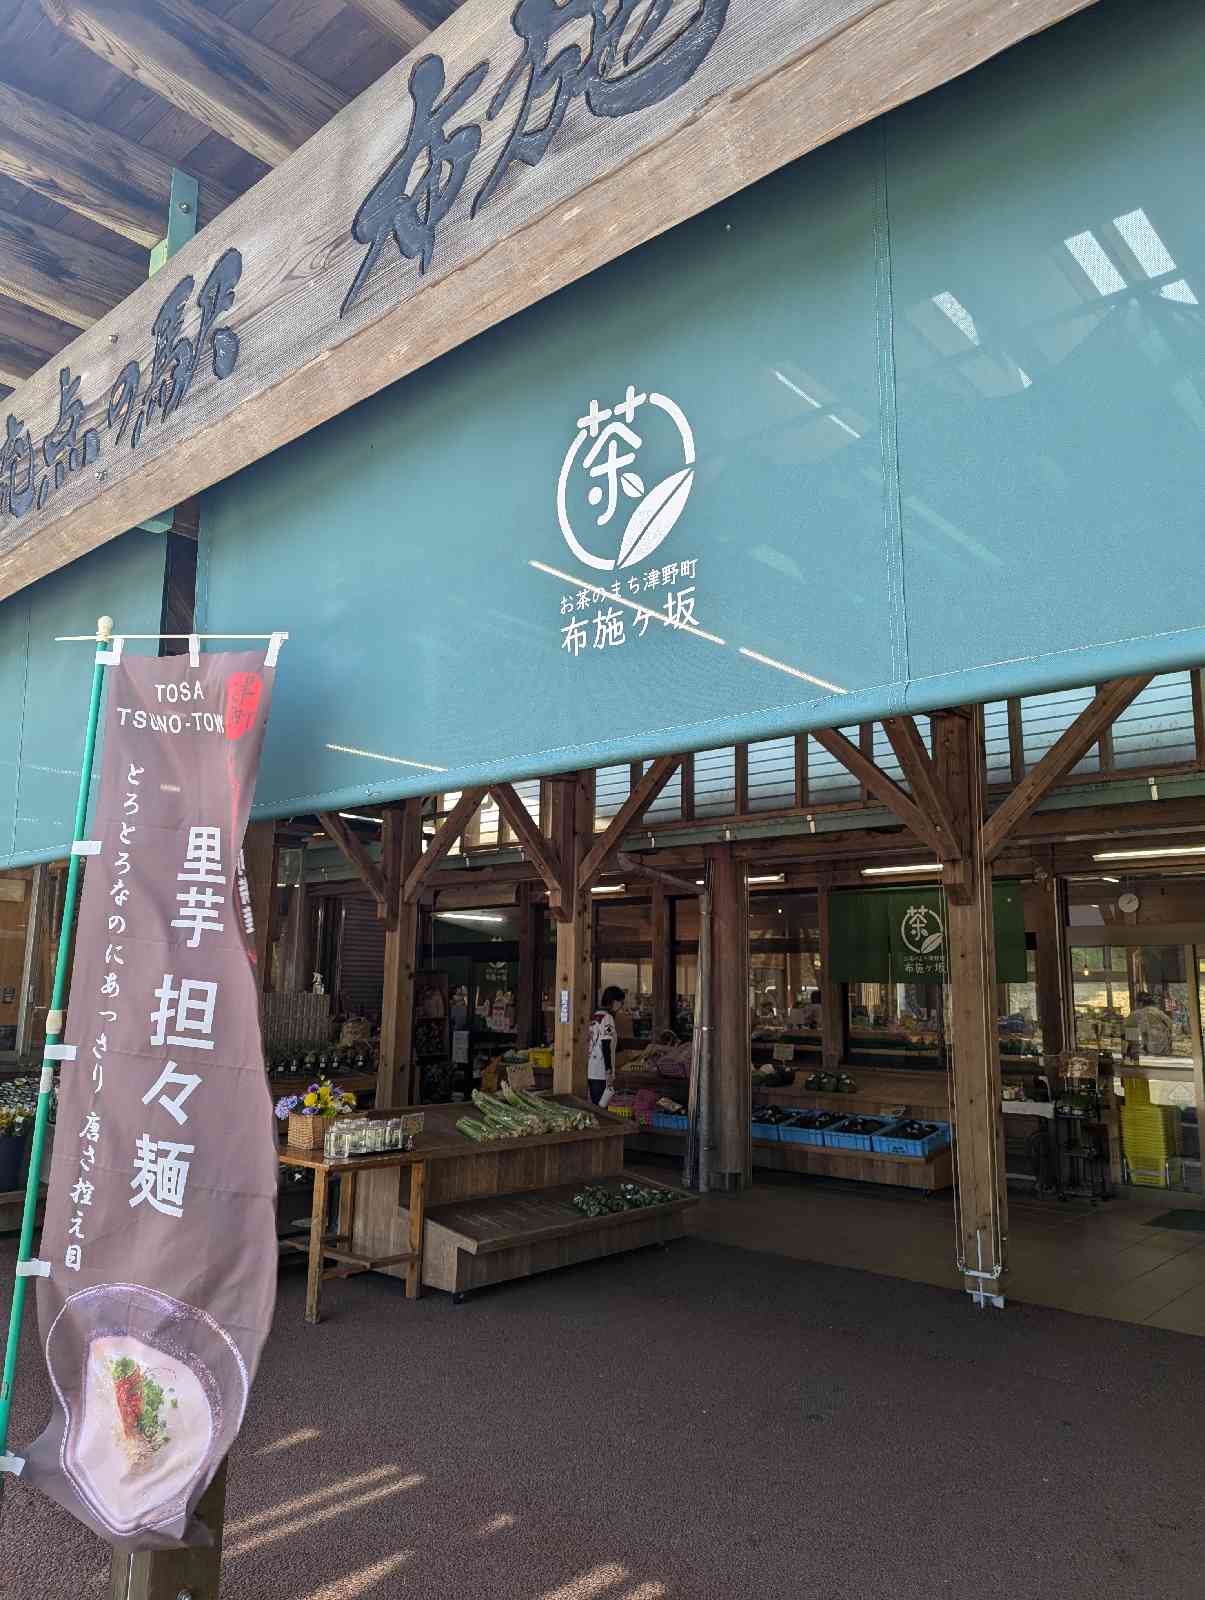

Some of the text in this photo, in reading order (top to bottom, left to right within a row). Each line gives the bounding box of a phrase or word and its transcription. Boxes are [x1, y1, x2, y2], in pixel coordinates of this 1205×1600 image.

[576, 384, 647, 526] 茶
[560, 558, 699, 614] お茶のまち津野町
[154, 679, 205, 703] TOSA
[91, 763, 145, 1094] とろとろなのにあっさり
[906, 904, 929, 941] 茶
[128, 973, 218, 1218] 担々麺
